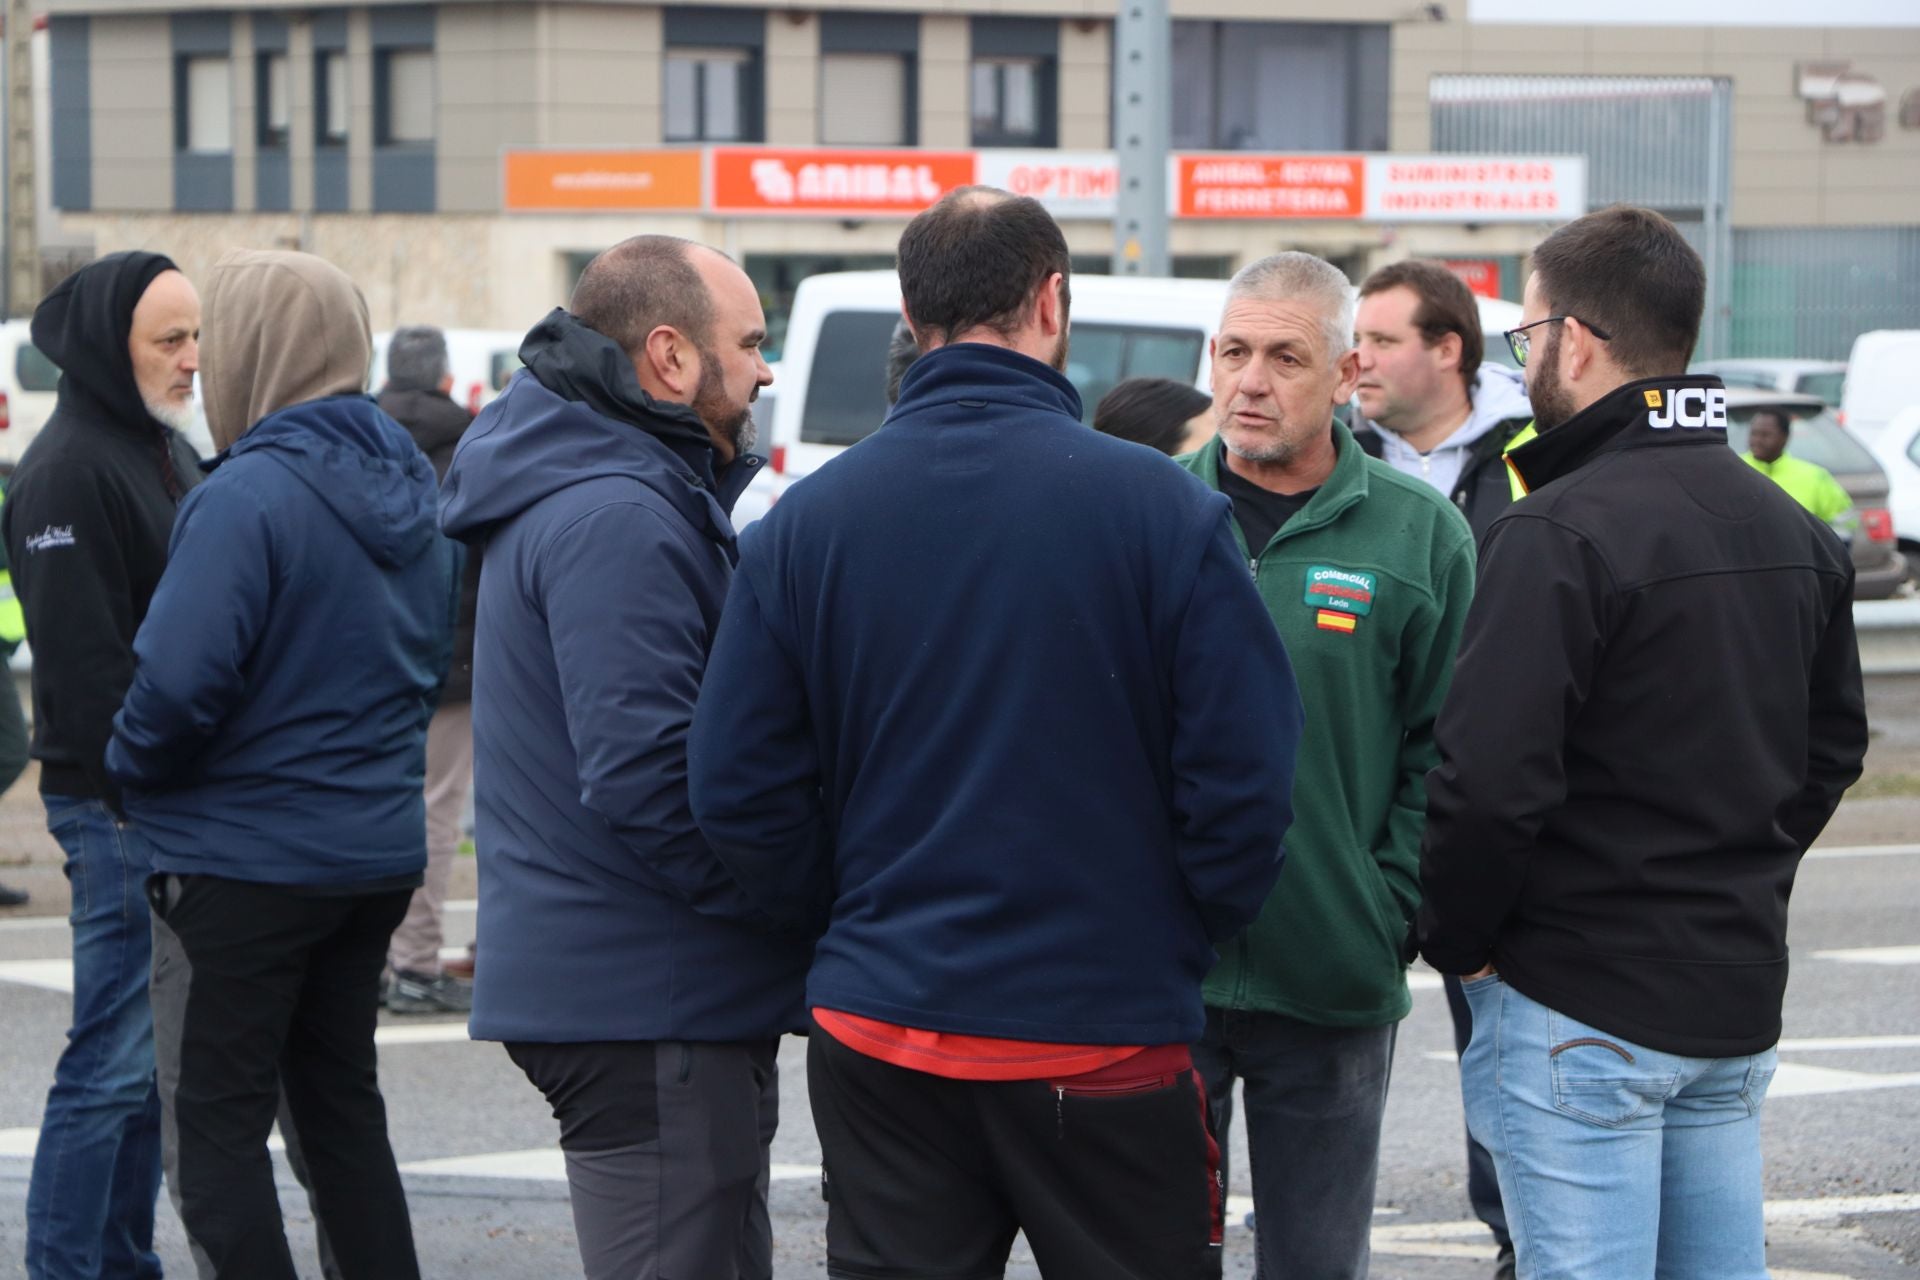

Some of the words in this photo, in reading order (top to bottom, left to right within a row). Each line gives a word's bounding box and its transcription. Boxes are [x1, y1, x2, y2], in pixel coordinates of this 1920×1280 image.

[799, 163, 941, 199] ANIBAL
[1007, 165, 1120, 197] OPTIM
[1388, 161, 1554, 183] SUMINISTROS
[1193, 187, 1349, 211] FERRETERIA
[1382, 191, 1559, 211] INDUSTRIALES
[1648, 388, 1727, 428] JCB
[1314, 571, 1370, 590] COMERCIAL
[1328, 596, 1349, 608] León
